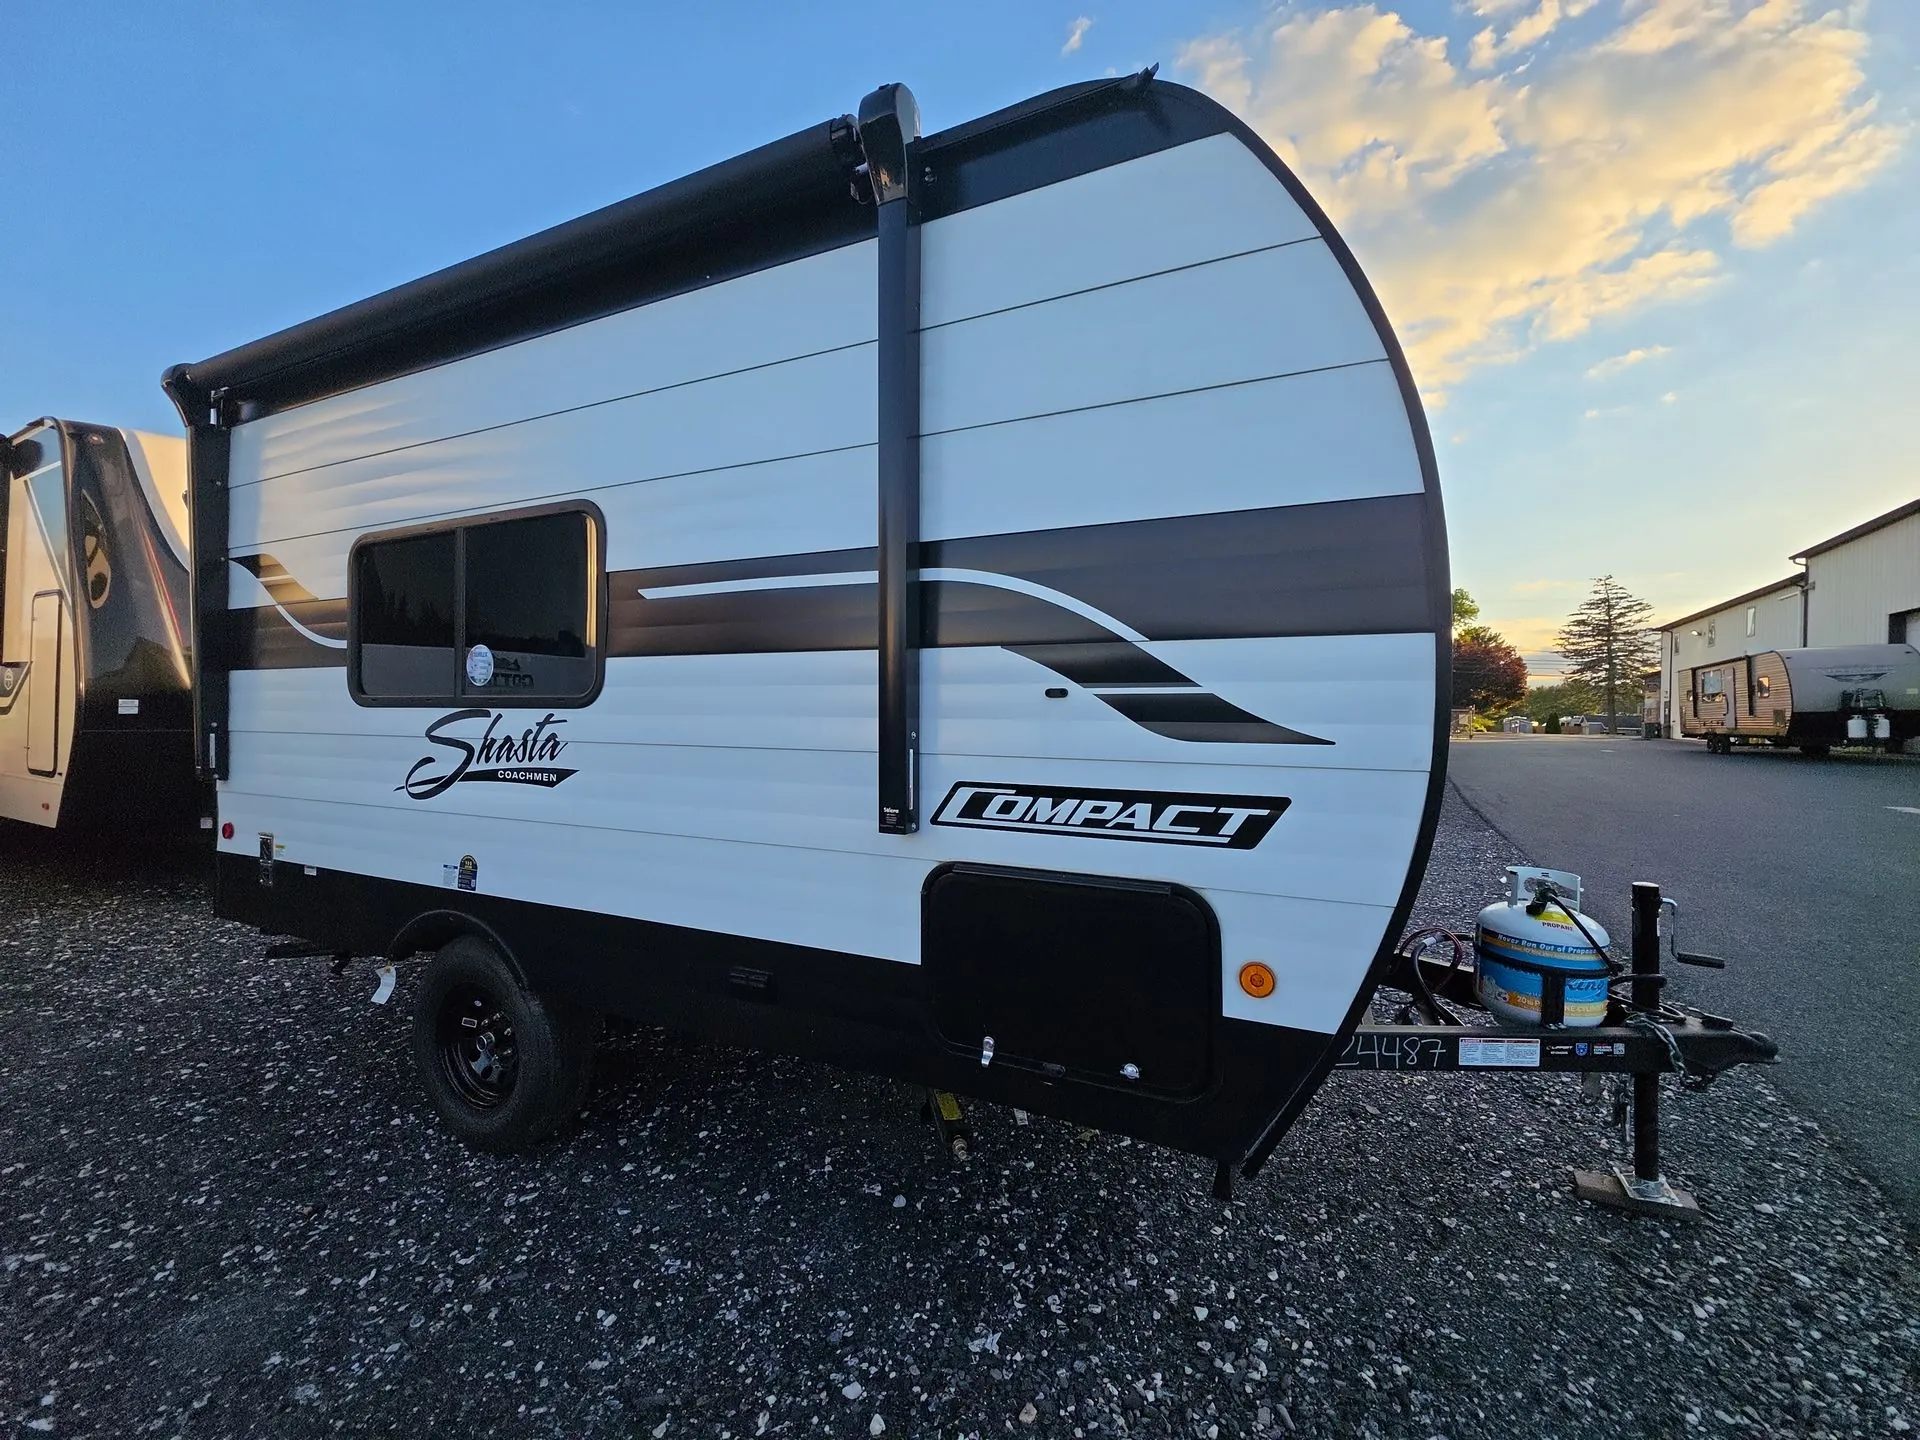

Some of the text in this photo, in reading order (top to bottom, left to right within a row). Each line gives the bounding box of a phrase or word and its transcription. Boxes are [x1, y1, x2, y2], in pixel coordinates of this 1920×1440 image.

[405, 709, 568, 800] Shasta
[497, 770, 557, 782] COACHMEN
[938, 786, 1270, 843] COMPACT
[1497, 932, 1519, 945] Never
[1521, 939, 1537, 949] Run
[1540, 943, 1555, 952] Out
[1557, 944, 1566, 953] of
